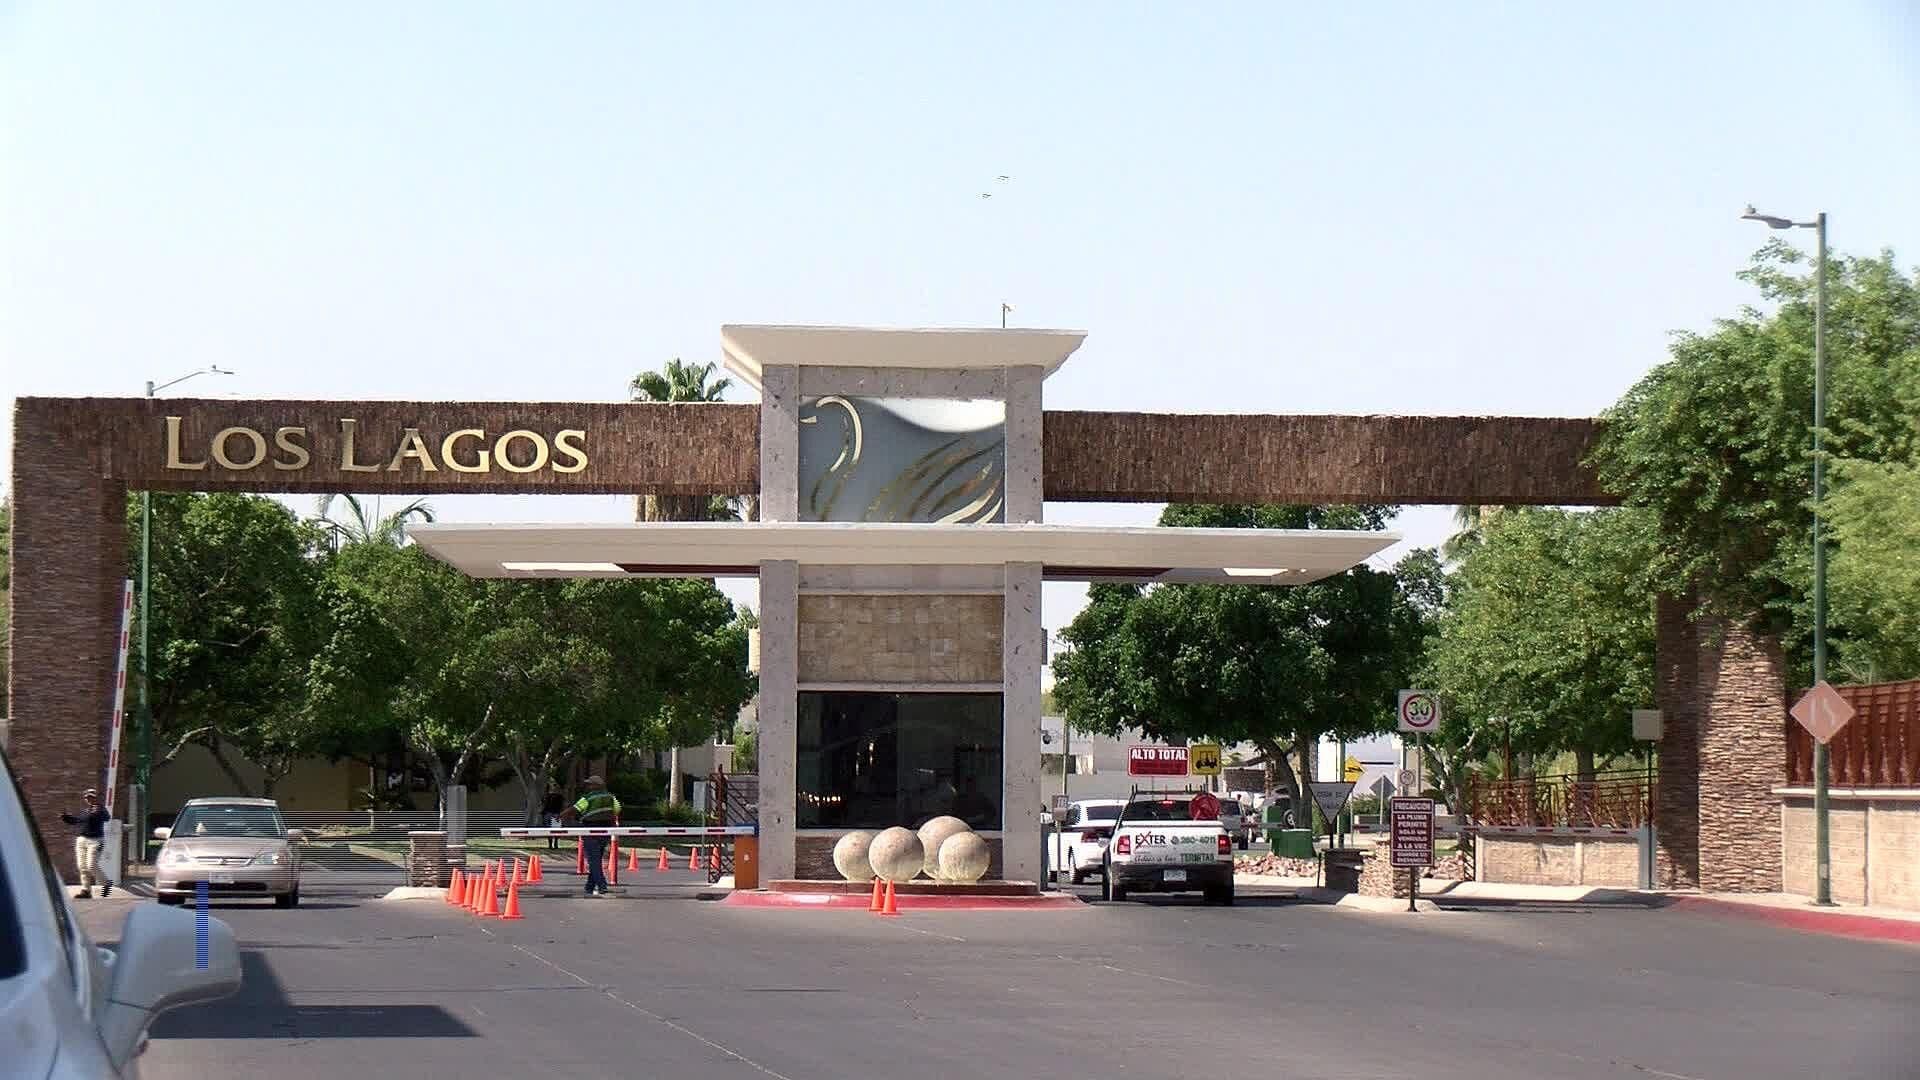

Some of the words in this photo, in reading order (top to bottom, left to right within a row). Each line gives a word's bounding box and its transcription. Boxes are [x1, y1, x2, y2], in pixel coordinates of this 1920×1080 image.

[165, 416, 311, 471] LOS
[340, 418, 589, 474] LAGOS
[1131, 748, 1156, 760] ALTO
[1157, 749, 1188, 761] TOTAL
[1135, 831, 1166, 847] EXTER
